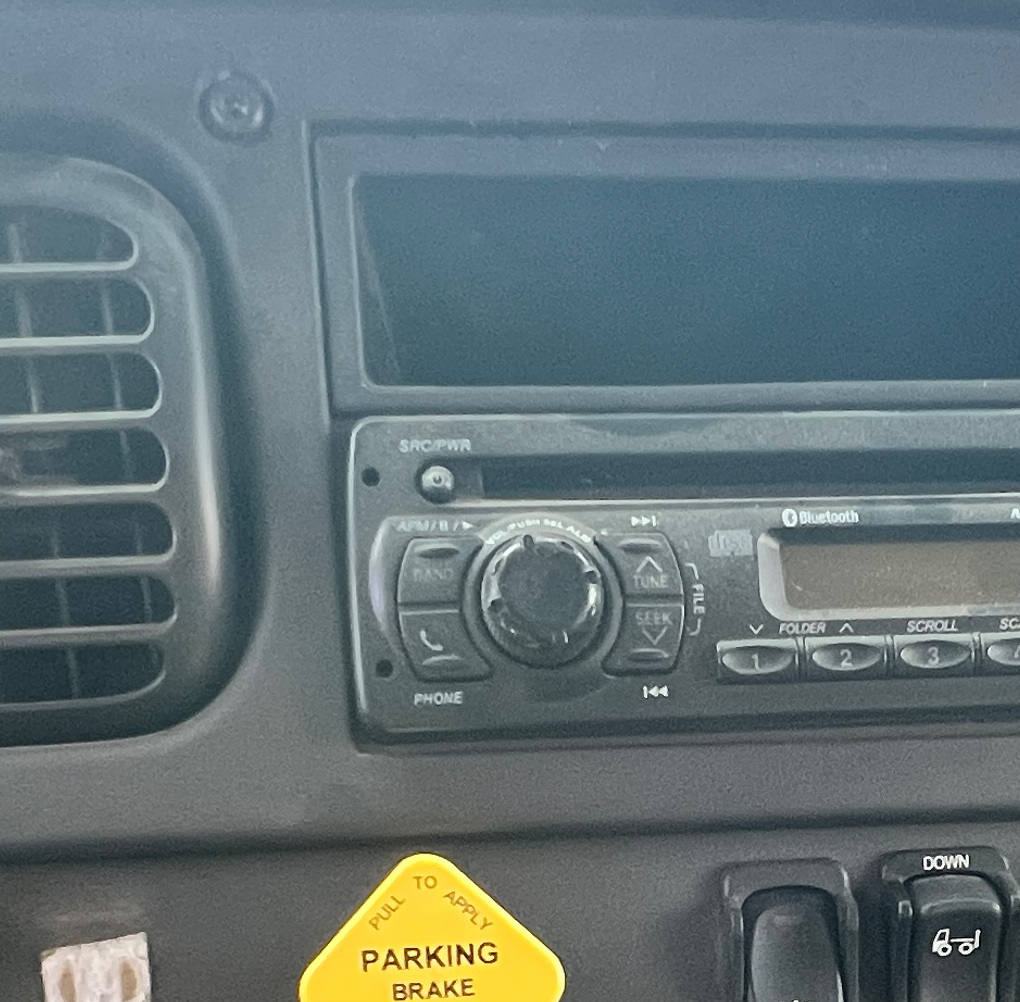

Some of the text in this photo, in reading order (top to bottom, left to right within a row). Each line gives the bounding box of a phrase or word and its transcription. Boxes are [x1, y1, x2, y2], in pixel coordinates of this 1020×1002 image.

[399, 438, 472, 453] SRC/PWR
[800, 509, 859, 525] Bluetooth
[633, 574, 669, 589] TUNE
[692, 583, 706, 615] FILE
[635, 611, 674, 626] SEEK
[906, 619, 959, 633] SCROLL
[779, 622, 826, 635] FOLDER
[752, 654, 760, 669] 1
[839, 649, 853, 667] 2
[927, 647, 940, 665] 3
[414, 690, 463, 706] PHONE
[922, 854, 970, 871] DOWN
[368, 875, 494, 932] PULL TO APPLY
[361, 942, 498, 973] PARKING
[392, 978, 476, 1002] BRAKE
